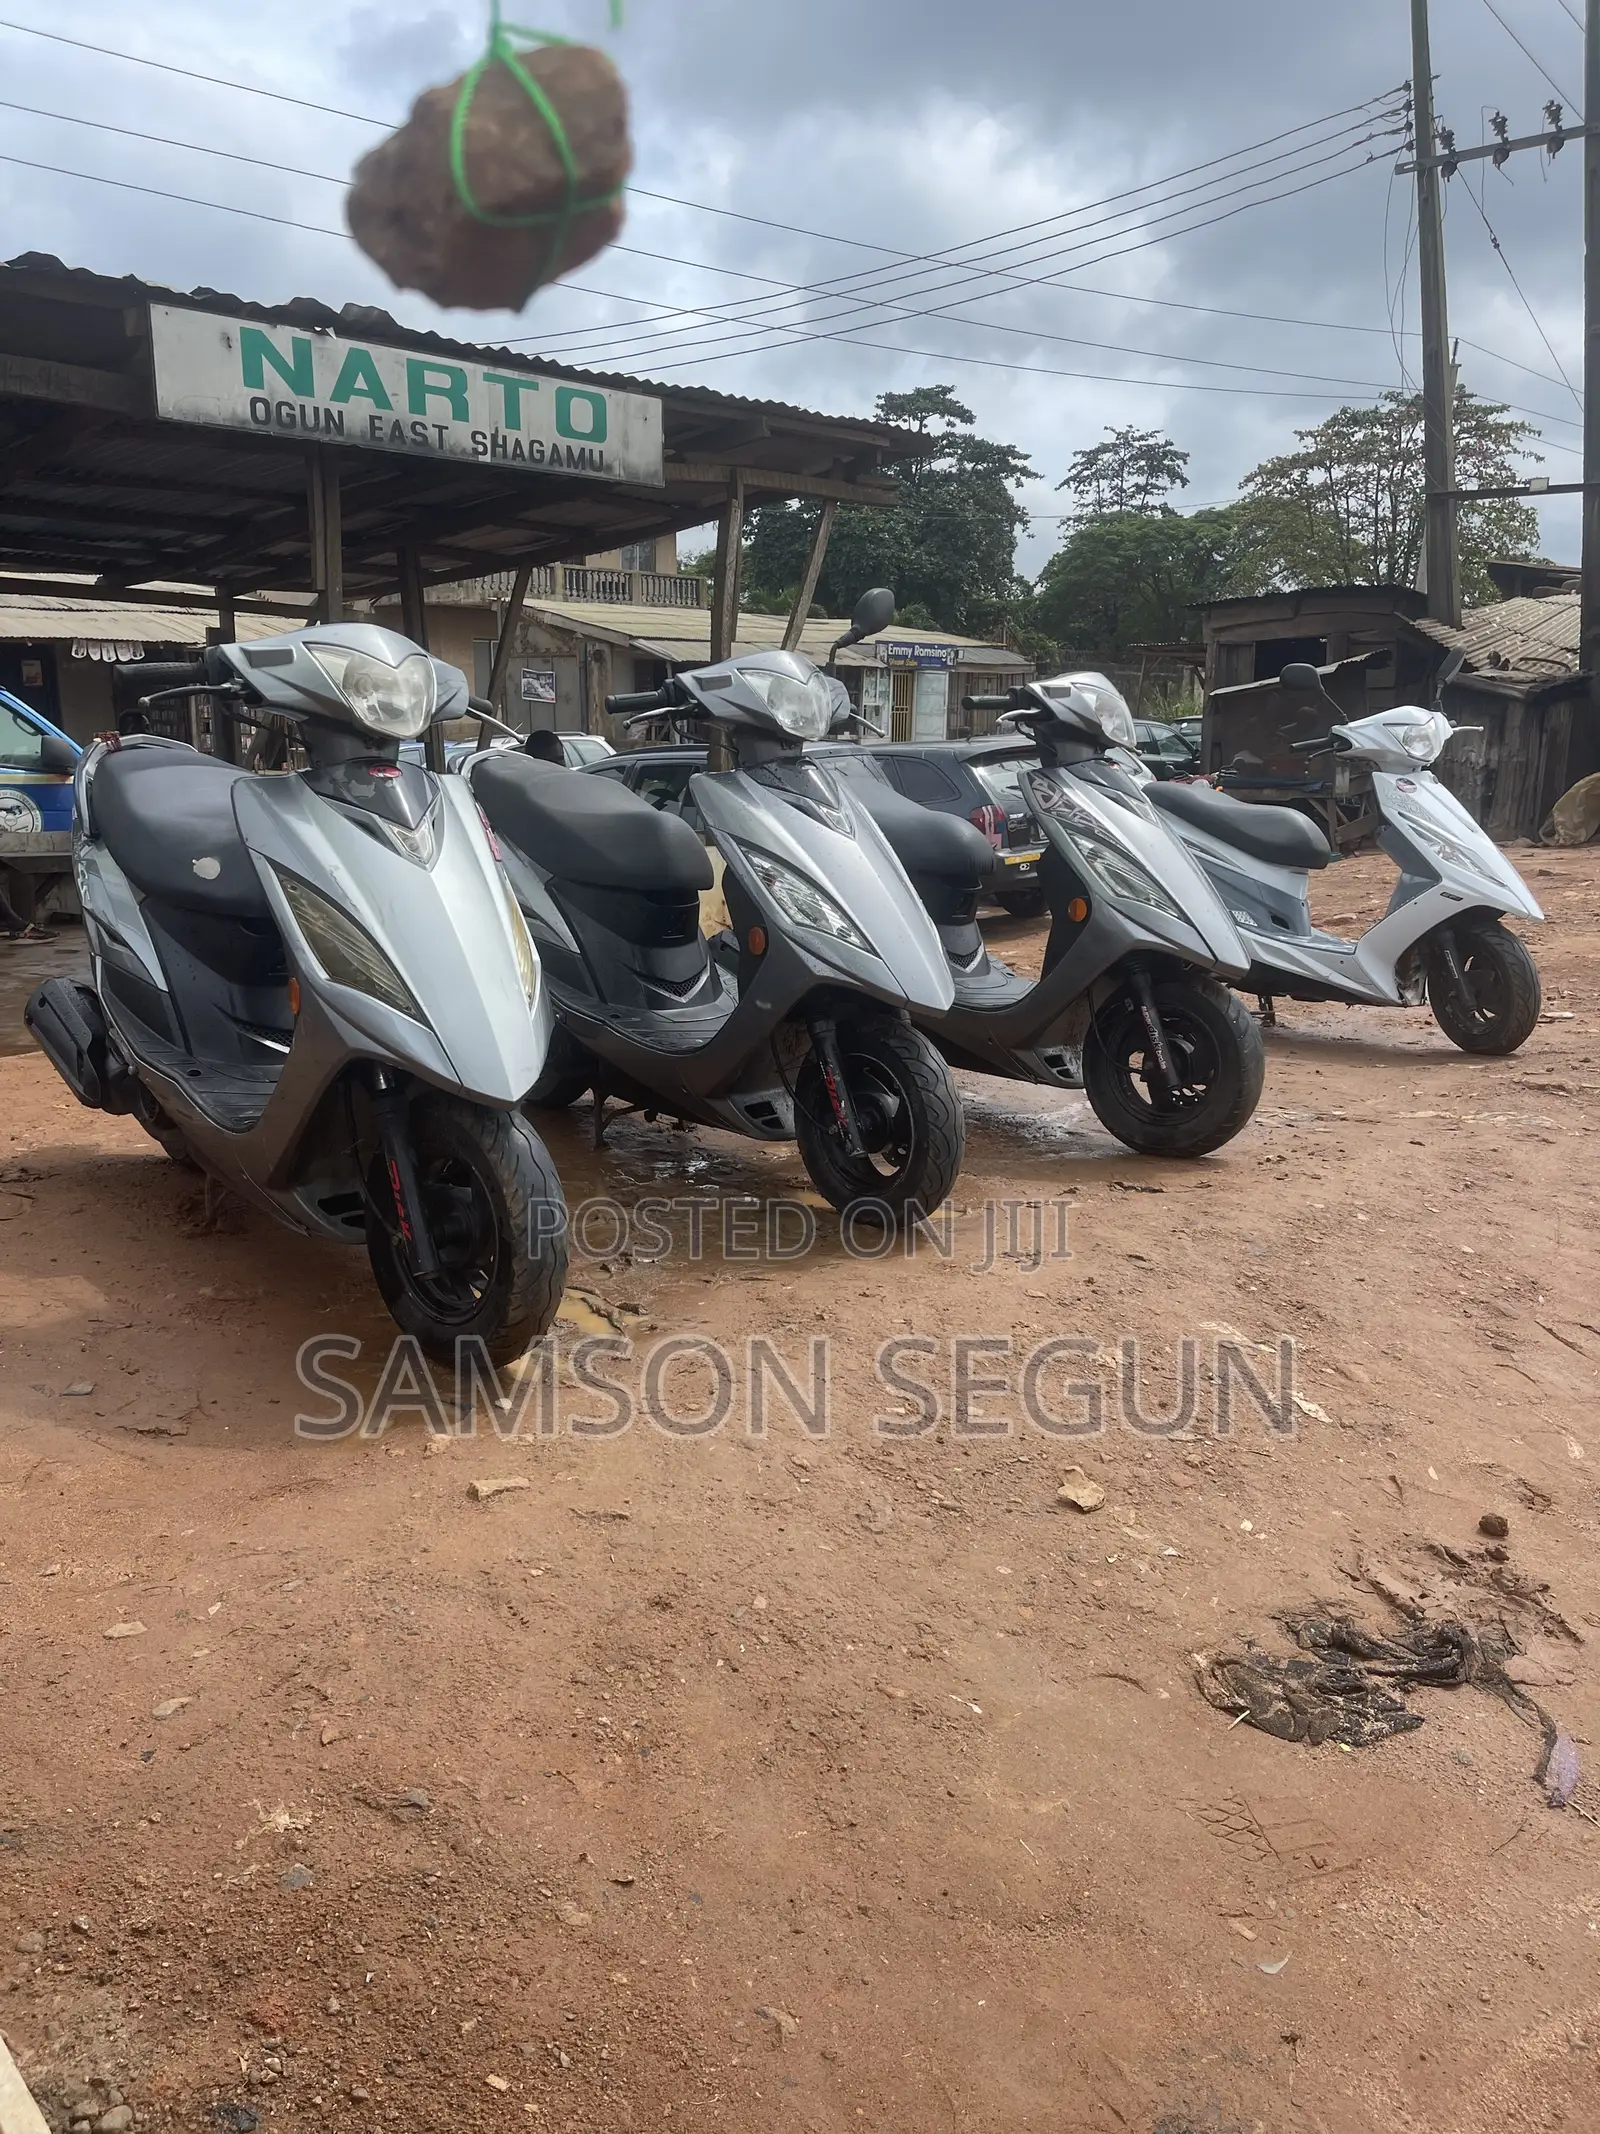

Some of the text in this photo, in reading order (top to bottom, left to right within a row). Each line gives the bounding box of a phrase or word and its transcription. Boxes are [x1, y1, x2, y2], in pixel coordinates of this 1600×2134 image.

[239, 326, 608, 444] NARTO
[249, 396, 604, 473] OGUN EAST SHAGAMU
[888, 643, 913, 658] Emmy
